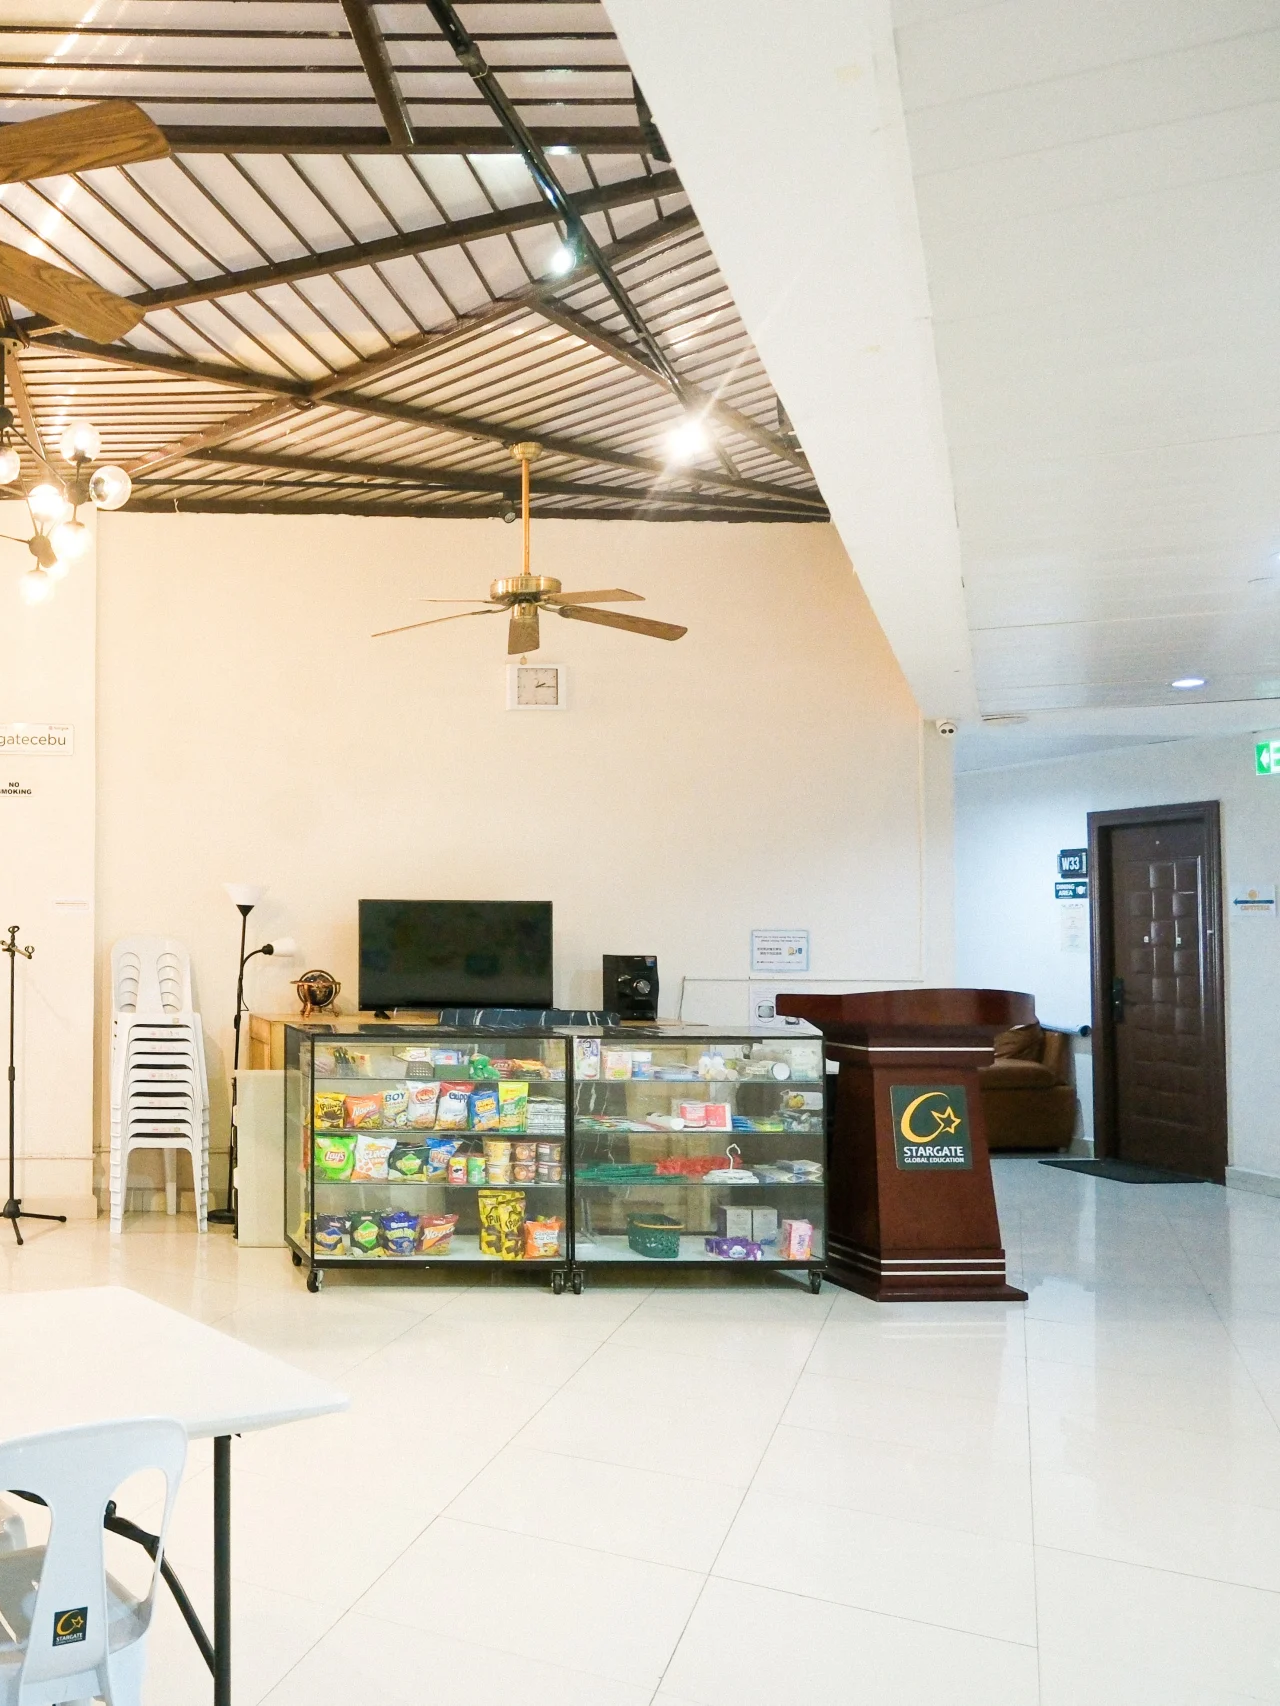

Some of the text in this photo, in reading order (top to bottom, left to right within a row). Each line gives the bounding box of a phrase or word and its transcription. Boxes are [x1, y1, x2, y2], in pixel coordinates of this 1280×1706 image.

[1061, 856, 1080, 870] W33
[384, 1092, 406, 1102] BOY
[326, 1151, 345, 1161] Lay's
[903, 1146, 965, 1157] STARGATE
[55, 1632, 83, 1643] STARGATE
